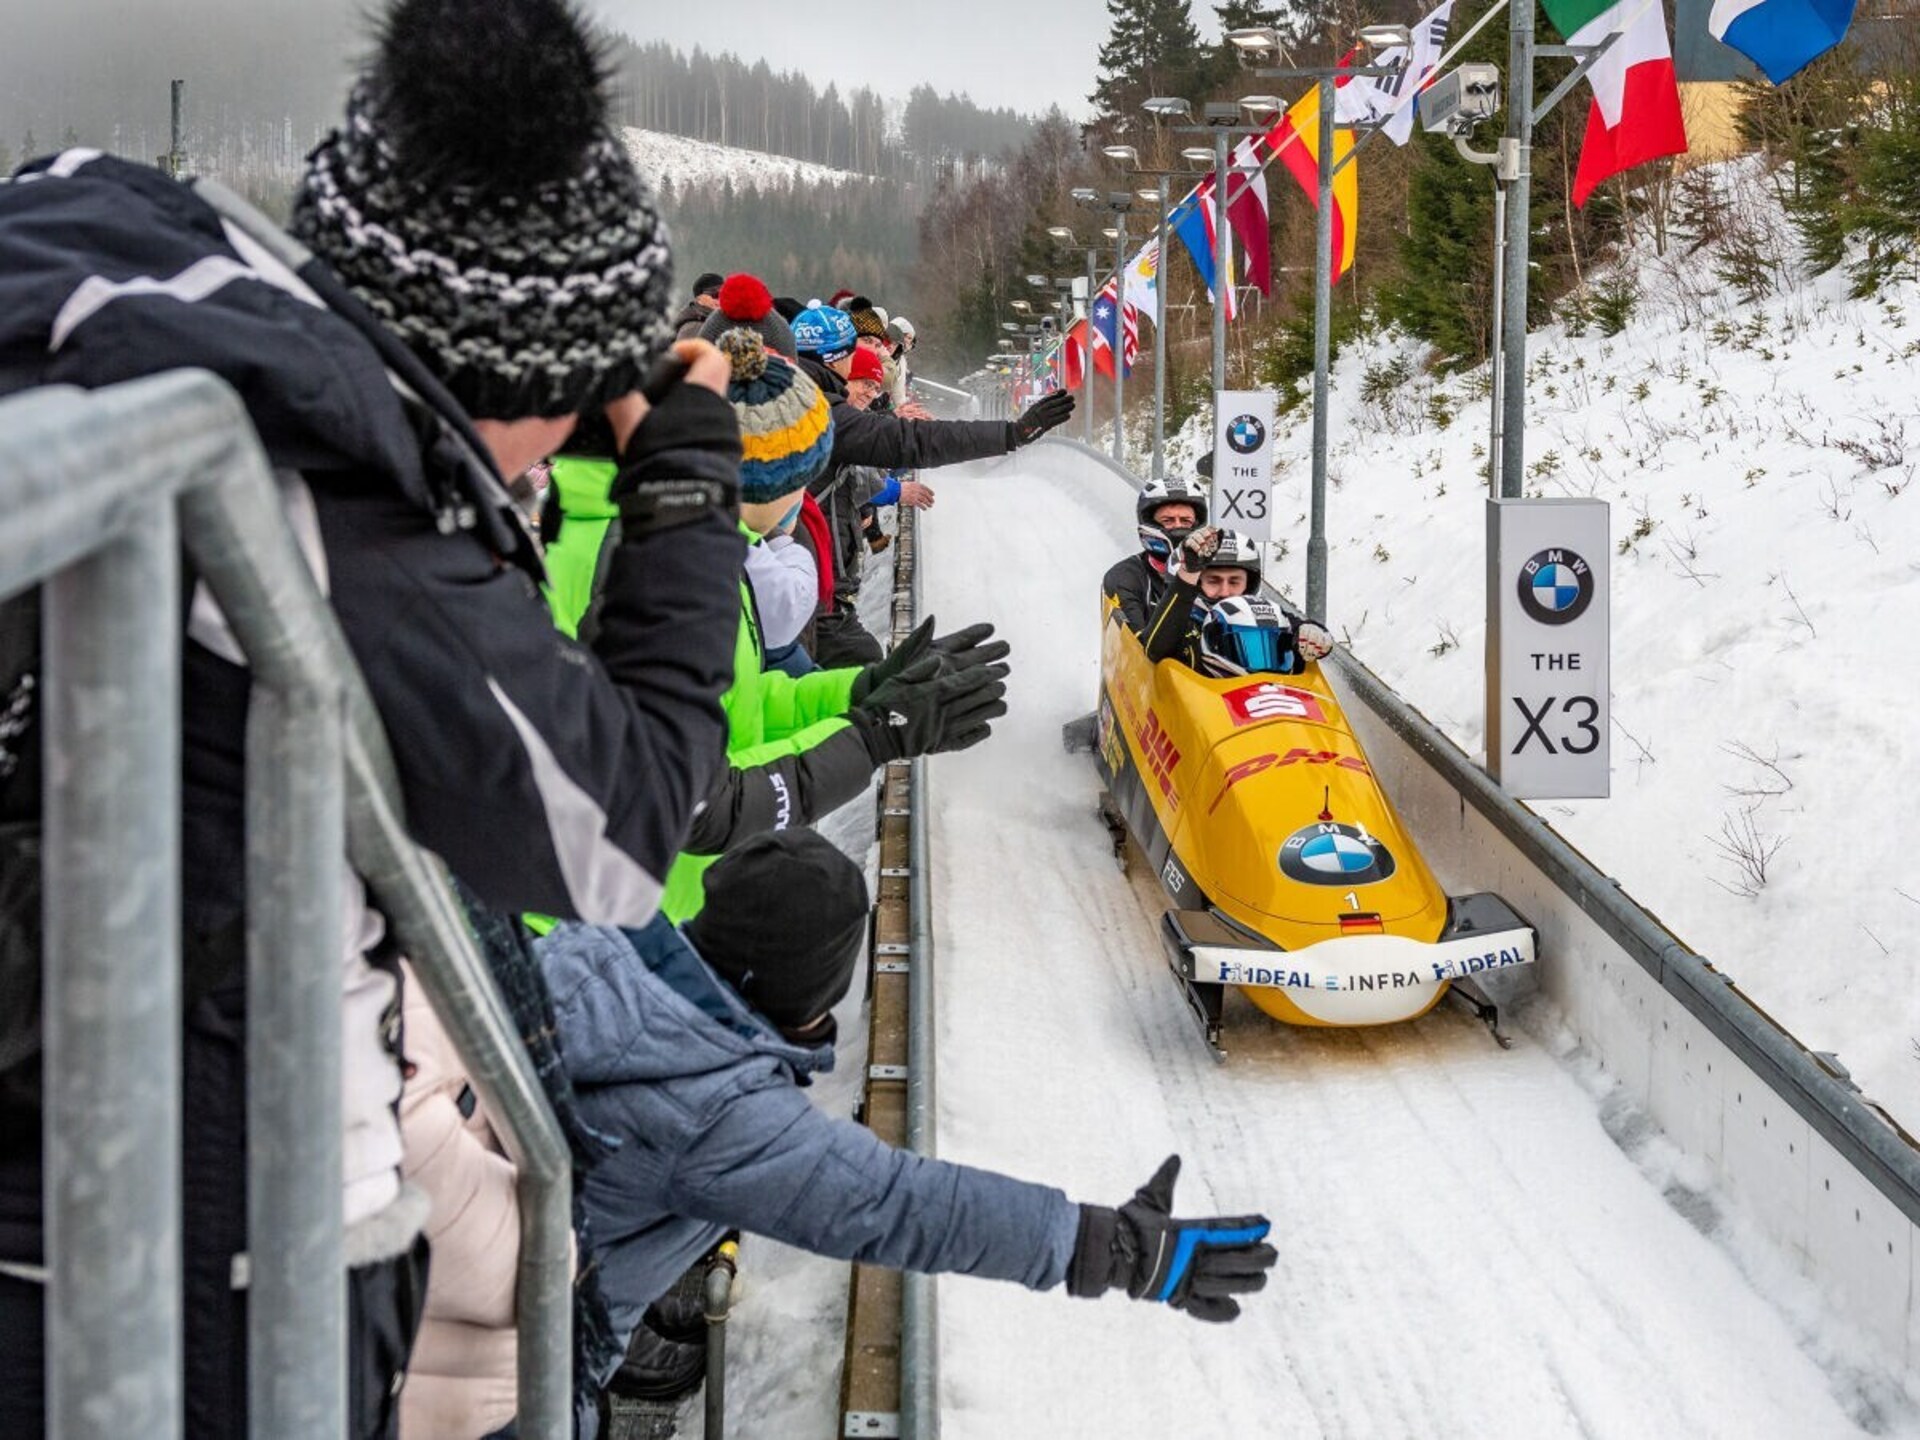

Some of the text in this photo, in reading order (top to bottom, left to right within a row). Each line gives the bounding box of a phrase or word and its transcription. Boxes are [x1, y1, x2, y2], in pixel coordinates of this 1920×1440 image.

[1232, 467, 1258, 477] THE
[1221, 489, 1266, 519] X3
[1525, 551, 1587, 575] BMW
[1531, 653, 1581, 670] THE
[1511, 696, 1600, 754] X3
[1139, 707, 1182, 798] DHL
[1219, 748, 1373, 800] DHL
[1285, 822, 1380, 849] BMW
[1162, 859, 1185, 893] FES
[1344, 892, 1360, 910] 1
[1459, 946, 1525, 975] IDEAL
[1247, 967, 1315, 988] IDEAL
